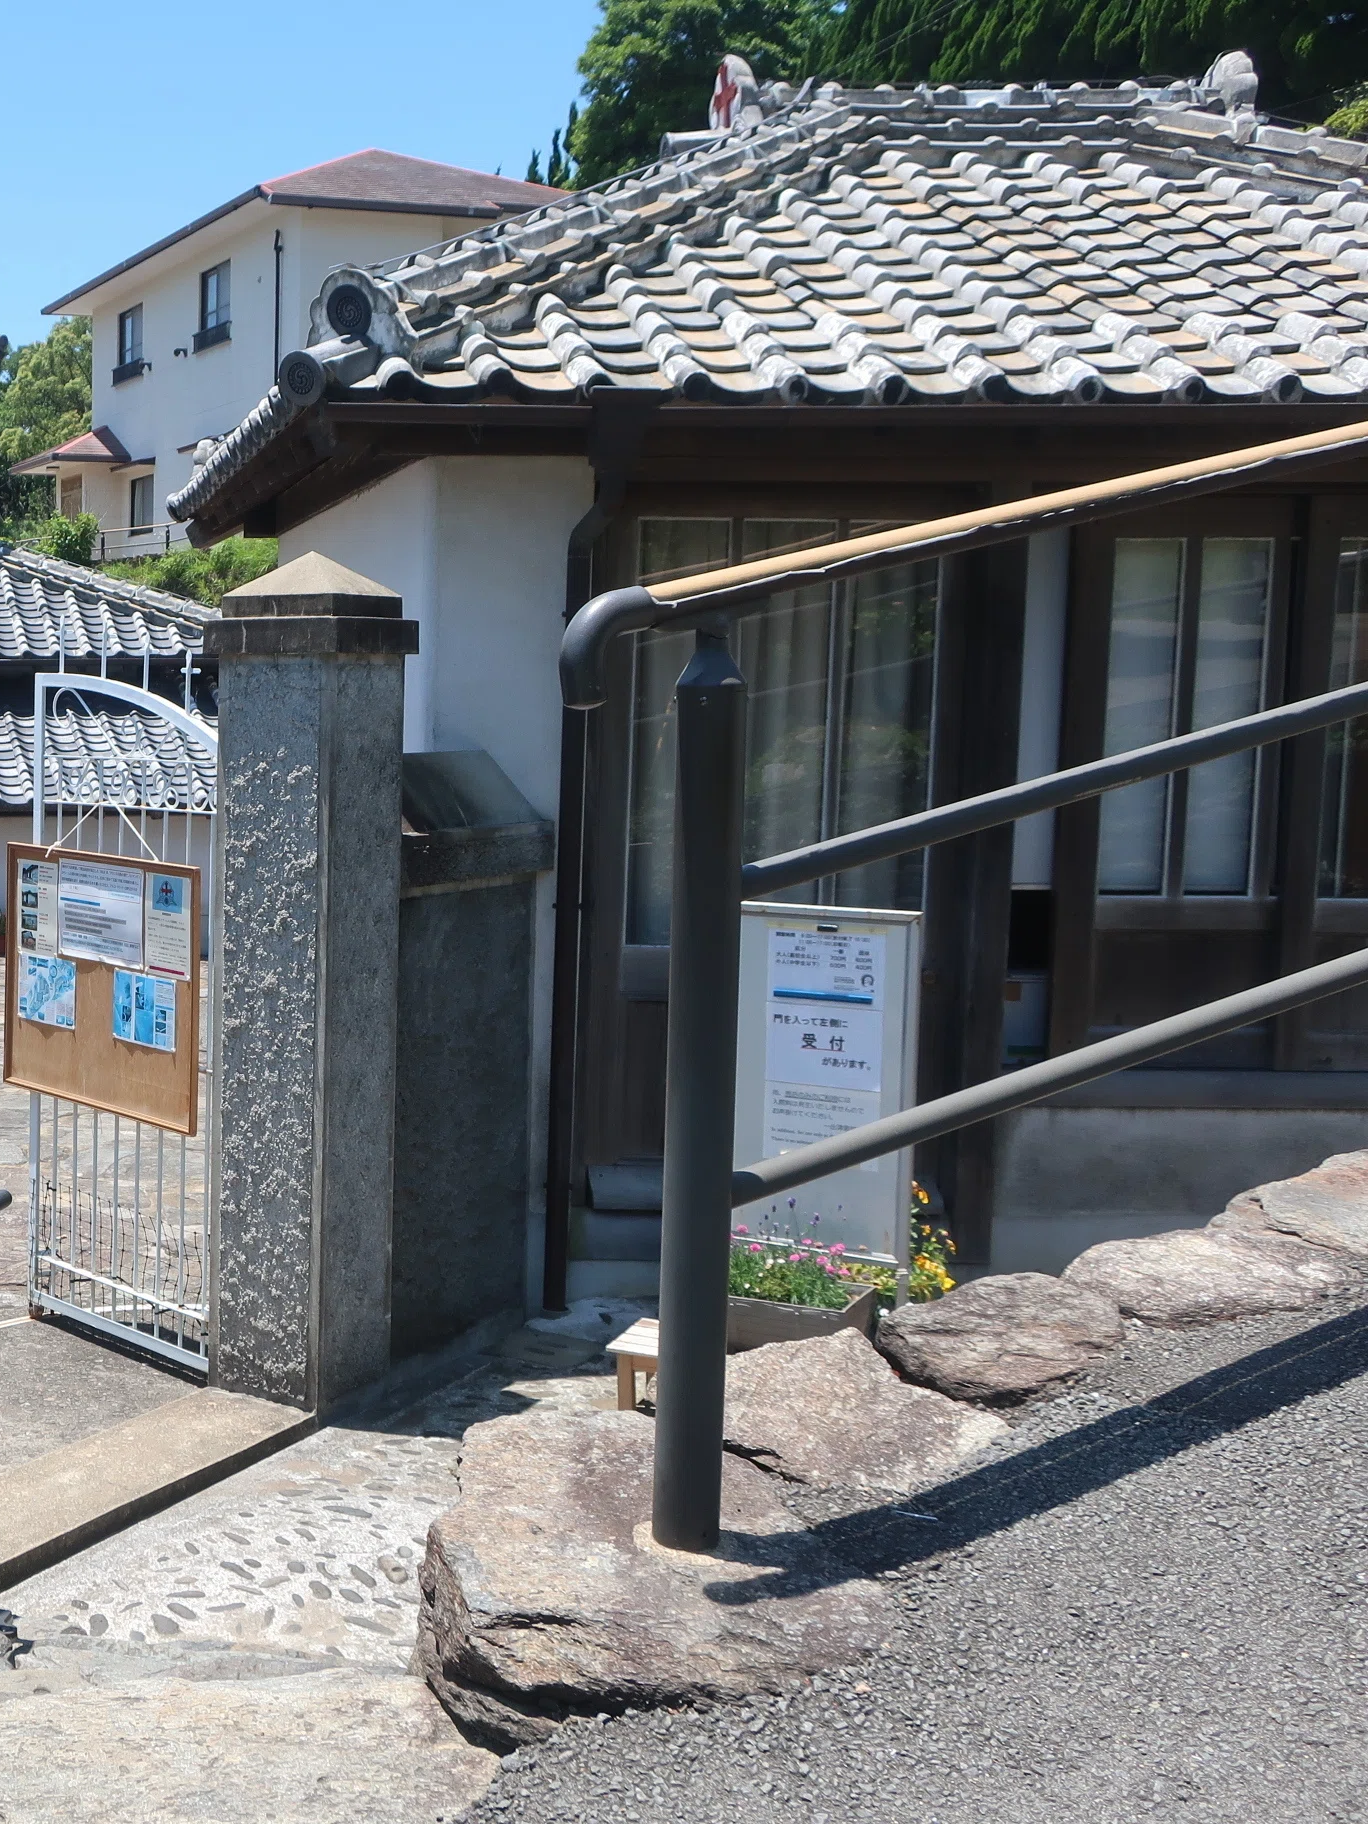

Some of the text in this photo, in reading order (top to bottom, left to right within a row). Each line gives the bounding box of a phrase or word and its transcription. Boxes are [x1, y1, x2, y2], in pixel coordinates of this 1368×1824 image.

[773, 1013, 848, 1028] 門を入って左側に
